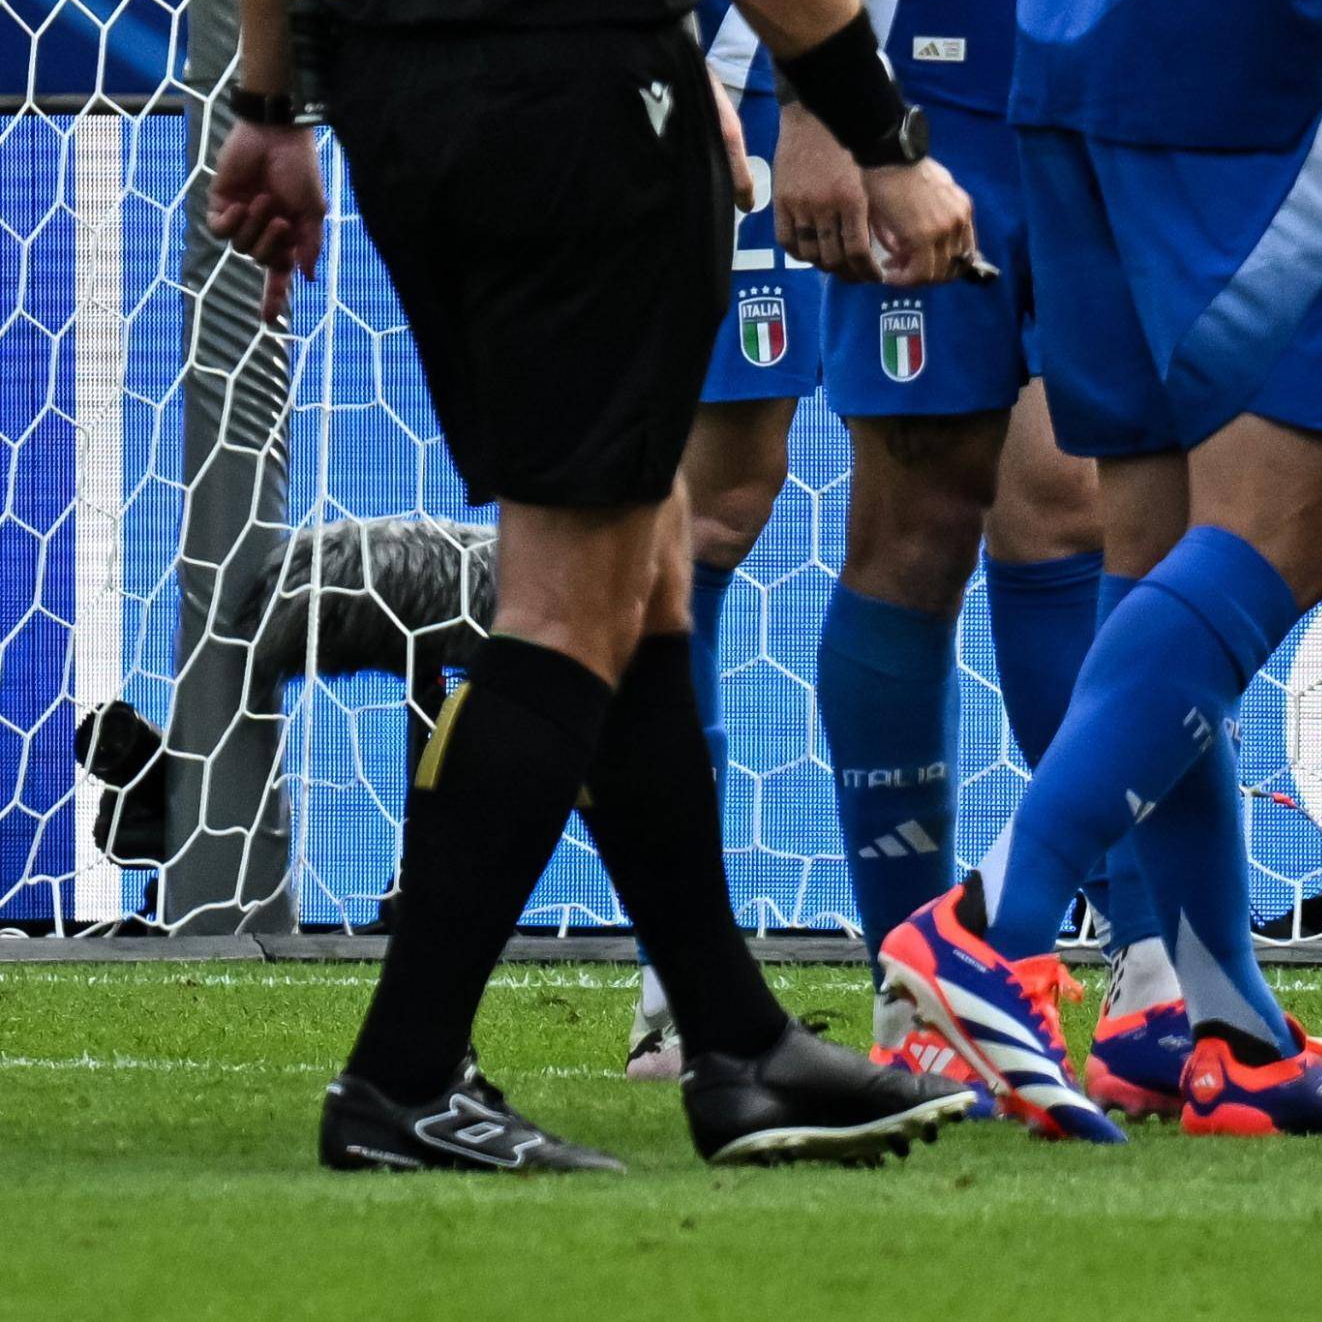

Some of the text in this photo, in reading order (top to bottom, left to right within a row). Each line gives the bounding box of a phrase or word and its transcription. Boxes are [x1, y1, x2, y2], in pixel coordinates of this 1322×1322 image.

[742, 303, 781, 319] ITALIA
[884, 316, 919, 331] ITALIA
[841, 761, 946, 789] ITALIA
